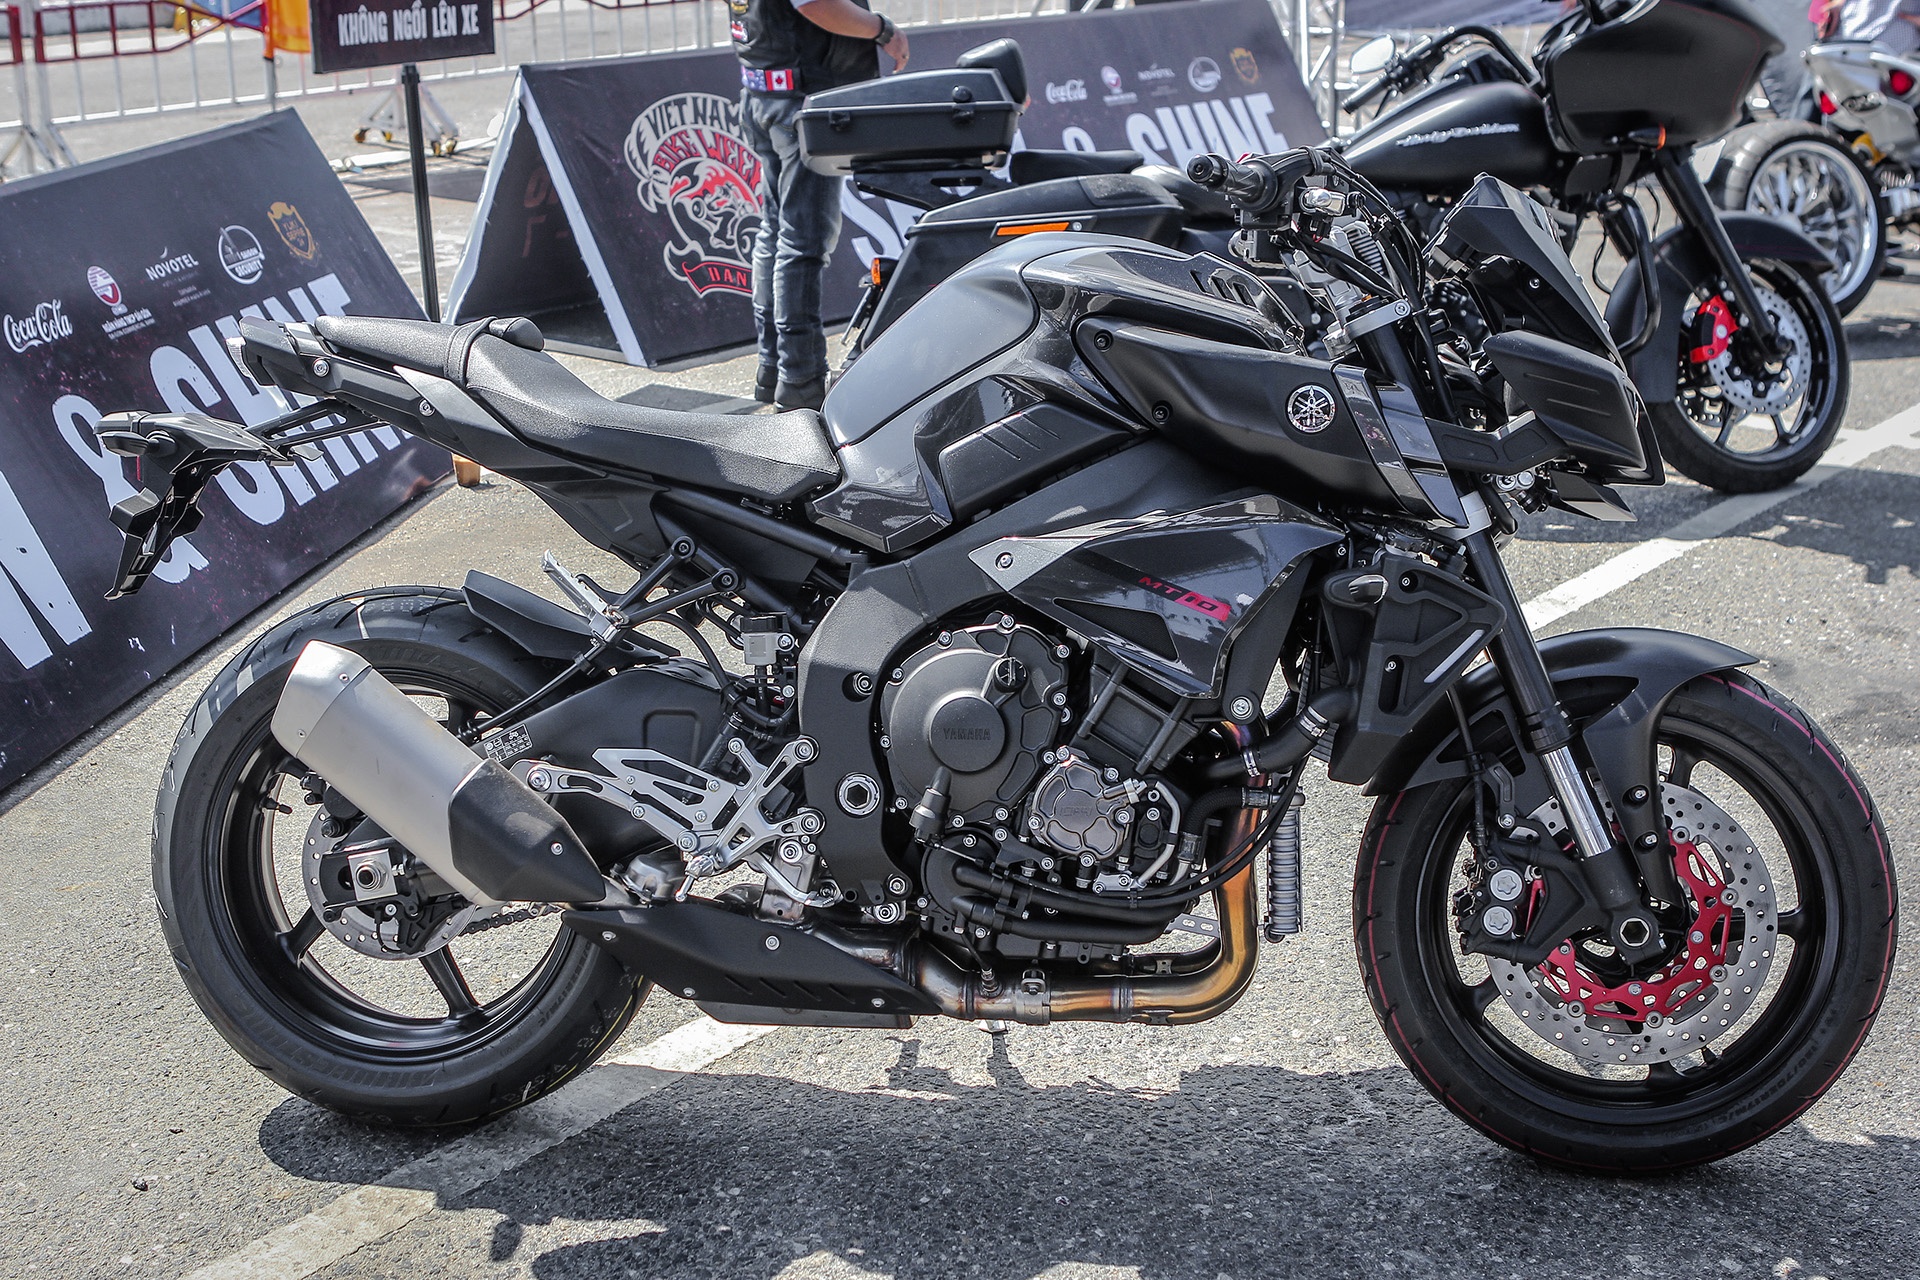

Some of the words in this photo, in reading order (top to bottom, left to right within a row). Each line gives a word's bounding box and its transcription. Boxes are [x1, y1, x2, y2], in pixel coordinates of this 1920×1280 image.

[338, 4, 388, 46] KHÔNG
[431, 0, 458, 38] LÊN
[461, 3, 480, 36] XE
[645, 98, 688, 141] VIET
[1125, 92, 1290, 168] SHINE
[653, 129, 702, 173] BIKE
[145, 253, 199, 281] NOVOTEL
[234, 259, 264, 278] SECURITY
[1138, 576, 1182, 594] MT
[943, 727, 991, 741] YAMAHA
